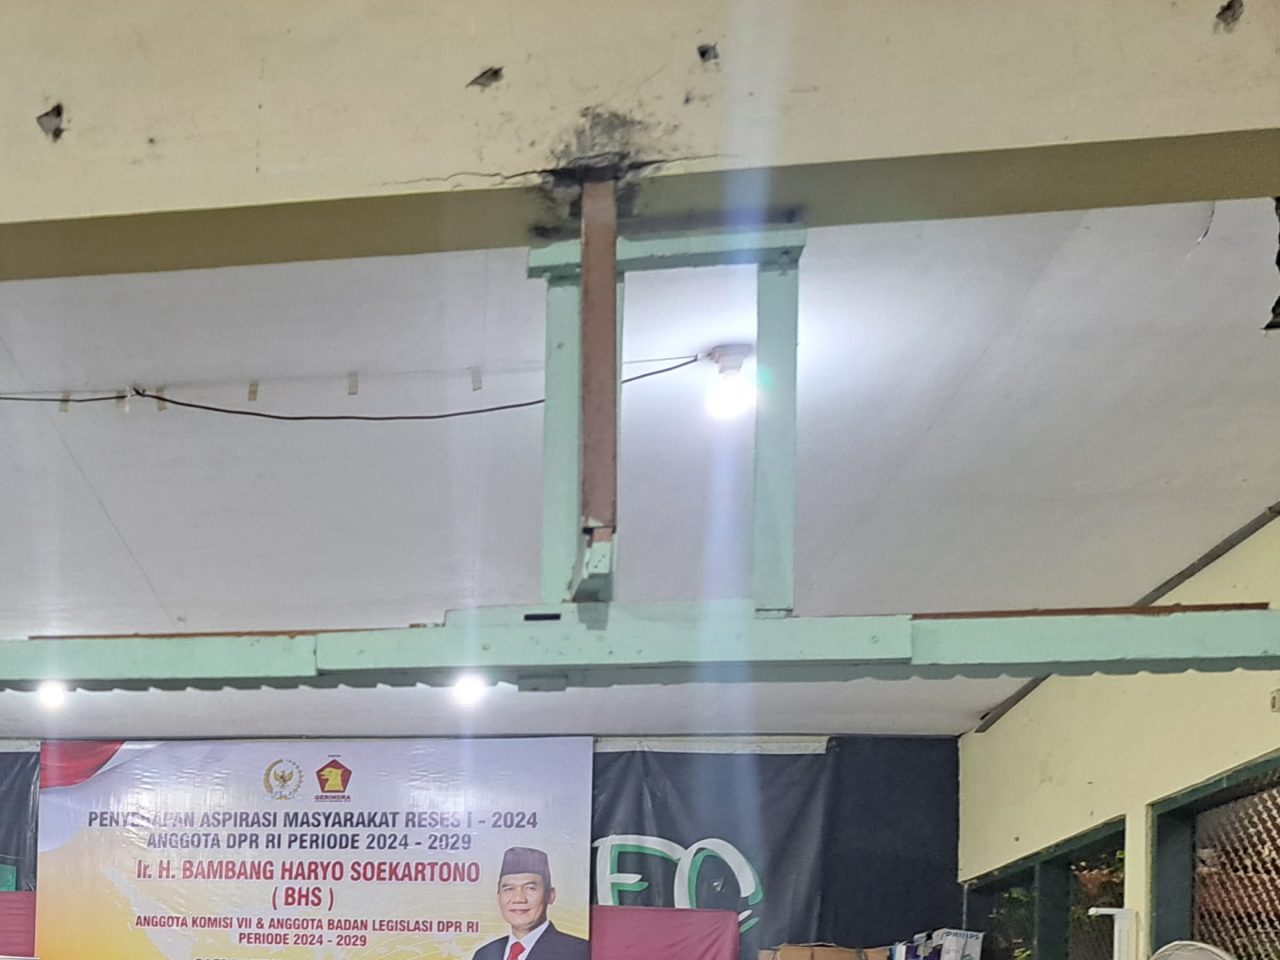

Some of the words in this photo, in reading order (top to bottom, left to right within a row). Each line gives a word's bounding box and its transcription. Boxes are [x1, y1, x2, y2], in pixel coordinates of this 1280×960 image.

[200, 811, 277, 828] ASPIRASI
[283, 811, 400, 828] MASYARAKAT
[404, 811, 461, 829] RESES
[466, 811, 473, 829] I
[491, 811, 538, 829] 2024
[147, 833, 221, 849] ANGGOTA
[226, 833, 260, 849] DPR
[265, 833, 282, 849] RI
[287, 833, 360, 849] PERIODE
[366, 833, 409, 850] 2024
[428, 834, 472, 850] 2029
[136, 859, 152, 880] Ir.
[158, 859, 176, 880] H.
[182, 860, 274, 880] BAMBANG
[280, 861, 344, 881] HARYO
[350, 861, 480, 882] SOEKARTONO
[284, 886, 322, 907] BHS
[135, 915, 188, 928] ANGGOTA
[191, 916, 233, 929] KOMISI
[237, 917, 252, 929] VII
[255, 917, 264, 930] &
[268, 918, 324, 930] ANGGOTA
[327, 919, 368, 931] BADAN
[372, 920, 433, 932] LEGISLASI
[437, 921, 462, 933] DPR
[466, 921, 479, 933] RI
[238, 933, 289, 945] PERIODE
[293, 934, 324, 946] 2024
[336, 935, 367, 947] 2029
[944, 931, 980, 940] PHILIPS
